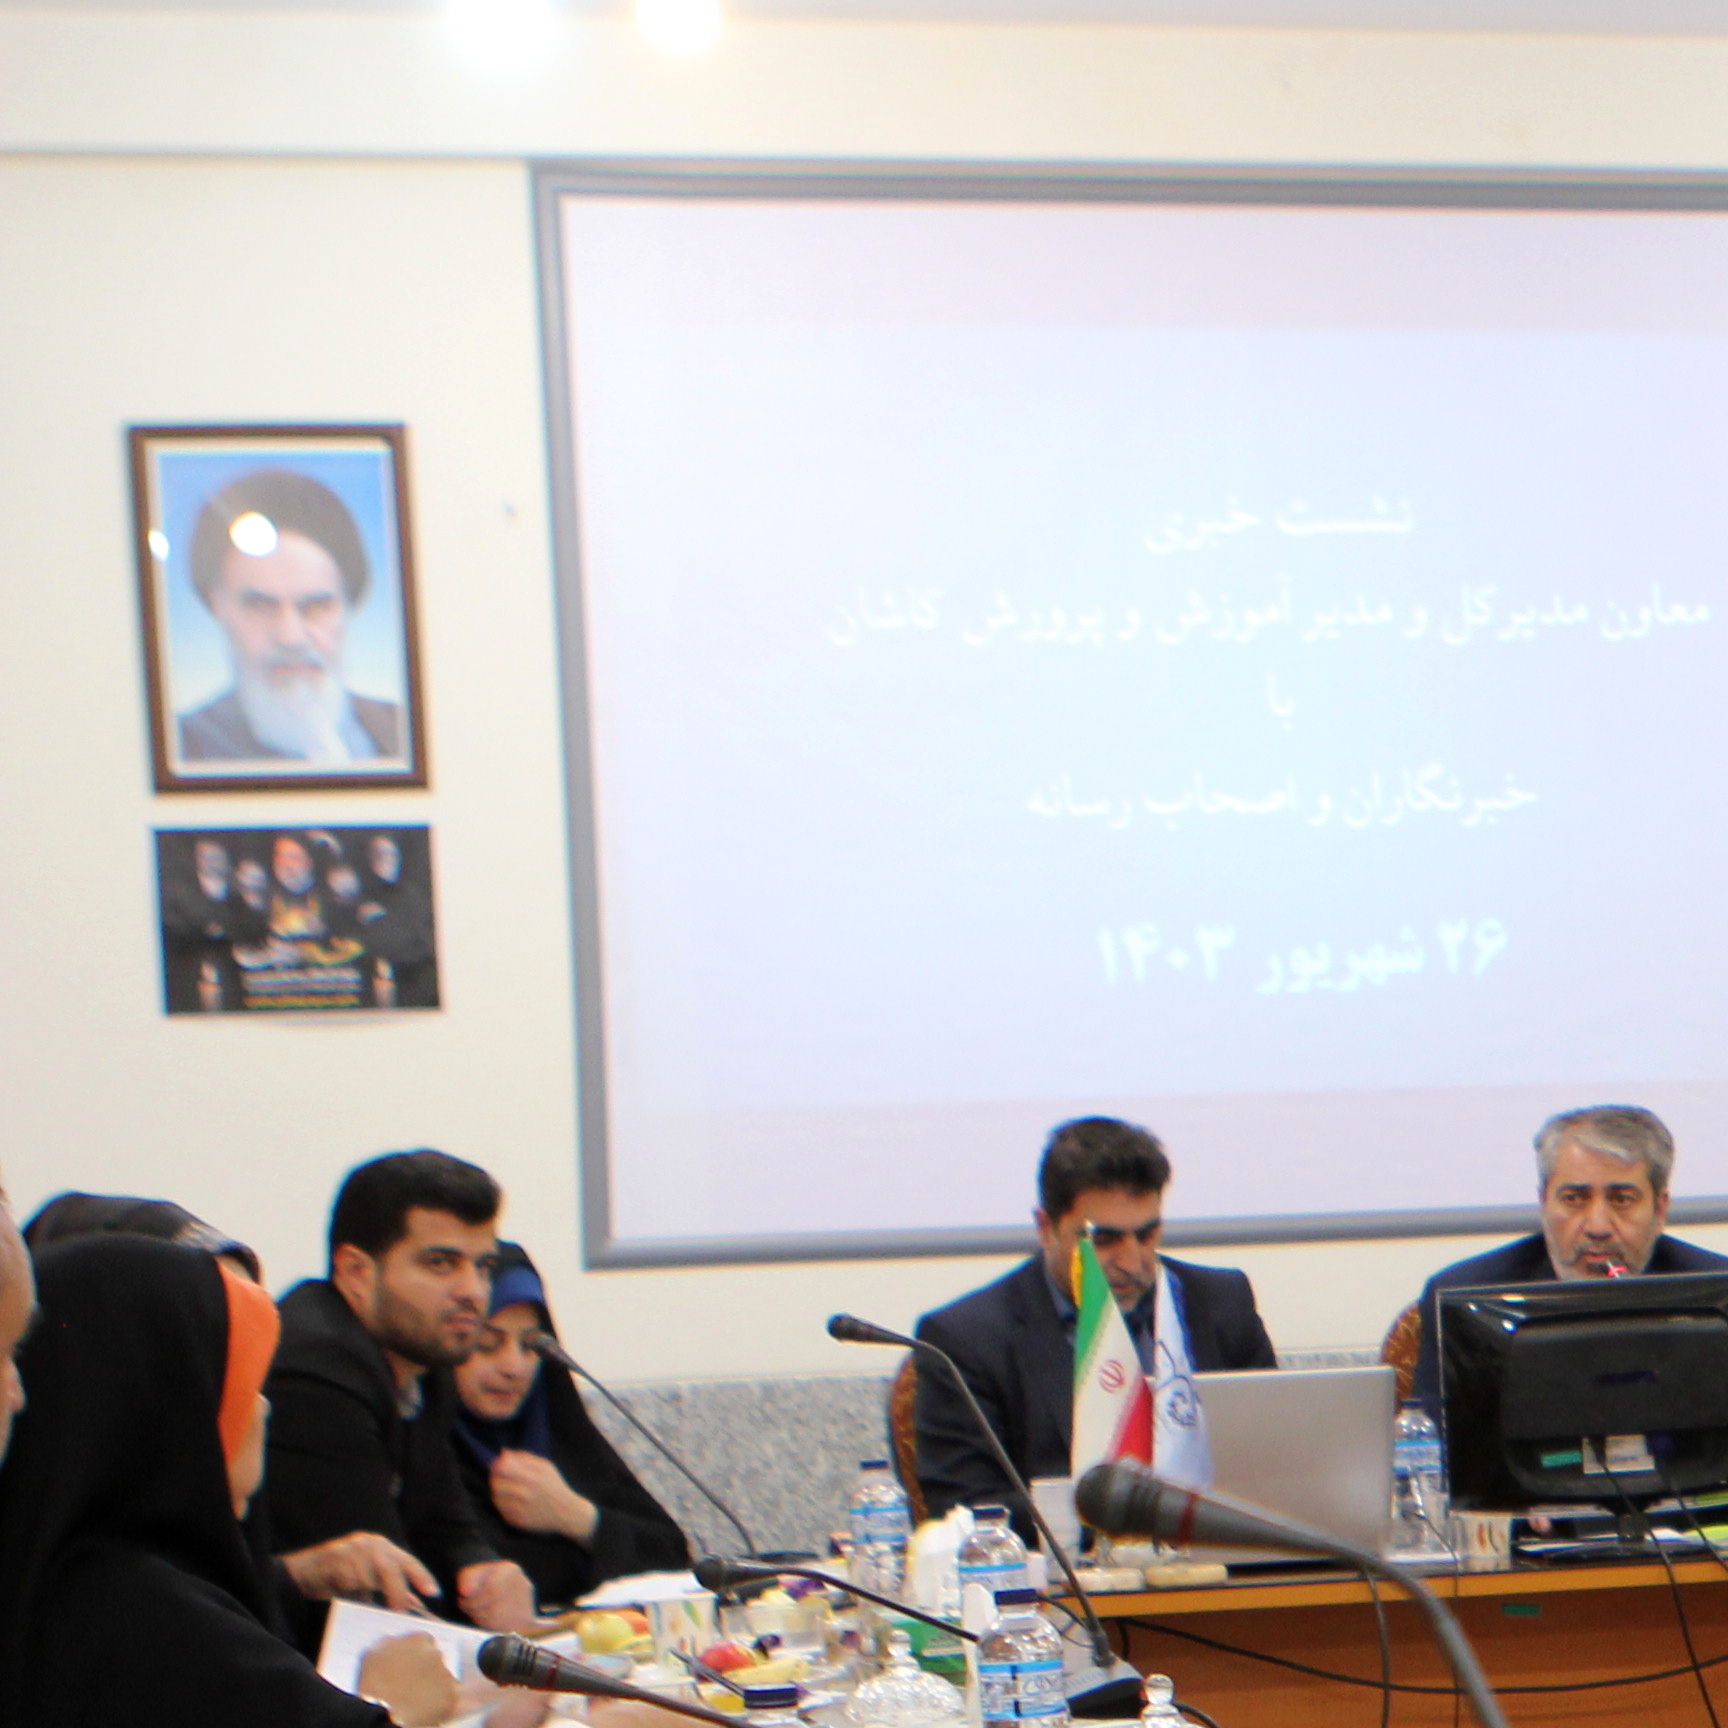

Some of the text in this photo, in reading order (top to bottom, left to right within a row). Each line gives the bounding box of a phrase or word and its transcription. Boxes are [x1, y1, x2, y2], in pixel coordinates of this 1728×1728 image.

[1143, 494, 1415, 555] نشست خبری
[825, 584, 943, 648] کاشان
[960, 589, 1104, 649] پرورش
[1112, 603, 1142, 642] و
[1152, 570, 1293, 647] آموزش
[1297, 591, 1394, 642] مدیر
[1402, 603, 1429, 641] و
[1599, 577, 1710, 641] معاون
[1264, 669, 1297, 731] با
[1023, 760, 1538, 832] خبرنگاران و اصحاب رسانه
[1097, 919, 1238, 983] ۱۴۰۳
[1252, 921, 1427, 995] شهریور
